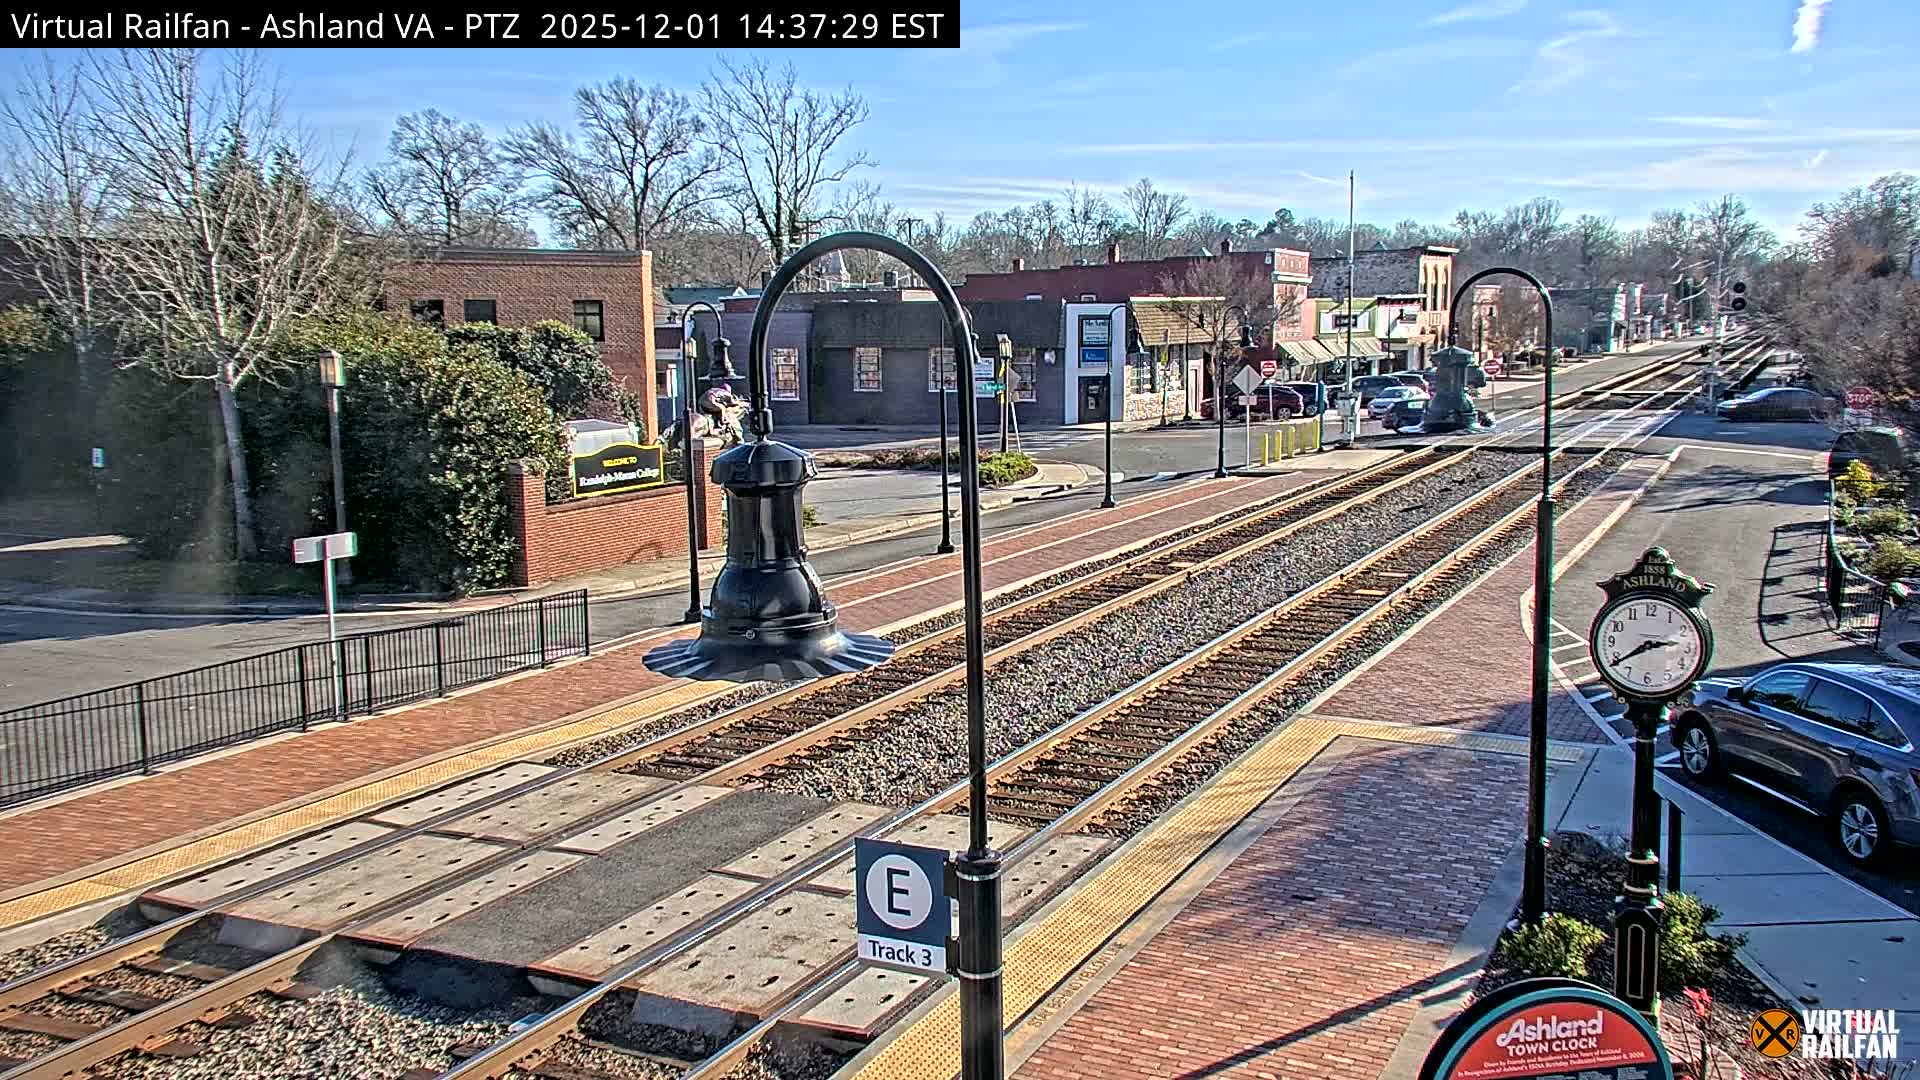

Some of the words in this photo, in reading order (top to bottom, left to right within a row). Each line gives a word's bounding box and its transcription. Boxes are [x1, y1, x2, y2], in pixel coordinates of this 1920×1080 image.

[1848, 394, 1871, 403] STOP
[1624, 575, 1686, 592] ASHLAND
[1628, 608, 1638, 620] 11
[1646, 605, 1657, 616] 12
[1667, 612, 1672, 624] 1
[1612, 620, 1624, 632] 10
[1680, 624, 1687, 637] 2
[1608, 636, 1615, 648] 9
[1684, 642, 1692, 654] 3
[1677, 657, 1684, 670] 4
[1624, 666, 1632, 678] 7
[1644, 672, 1652, 684] 6
[1664, 670, 1672, 681] 5
[886, 867, 912, 917] E
[868, 940, 916, 965] Track
[921, 948, 932, 966] 3
[1496, 1010, 1603, 1047] Ashland
[1507, 1042, 1549, 1057] TOWN
[1552, 1037, 1598, 1052] CLOCK
